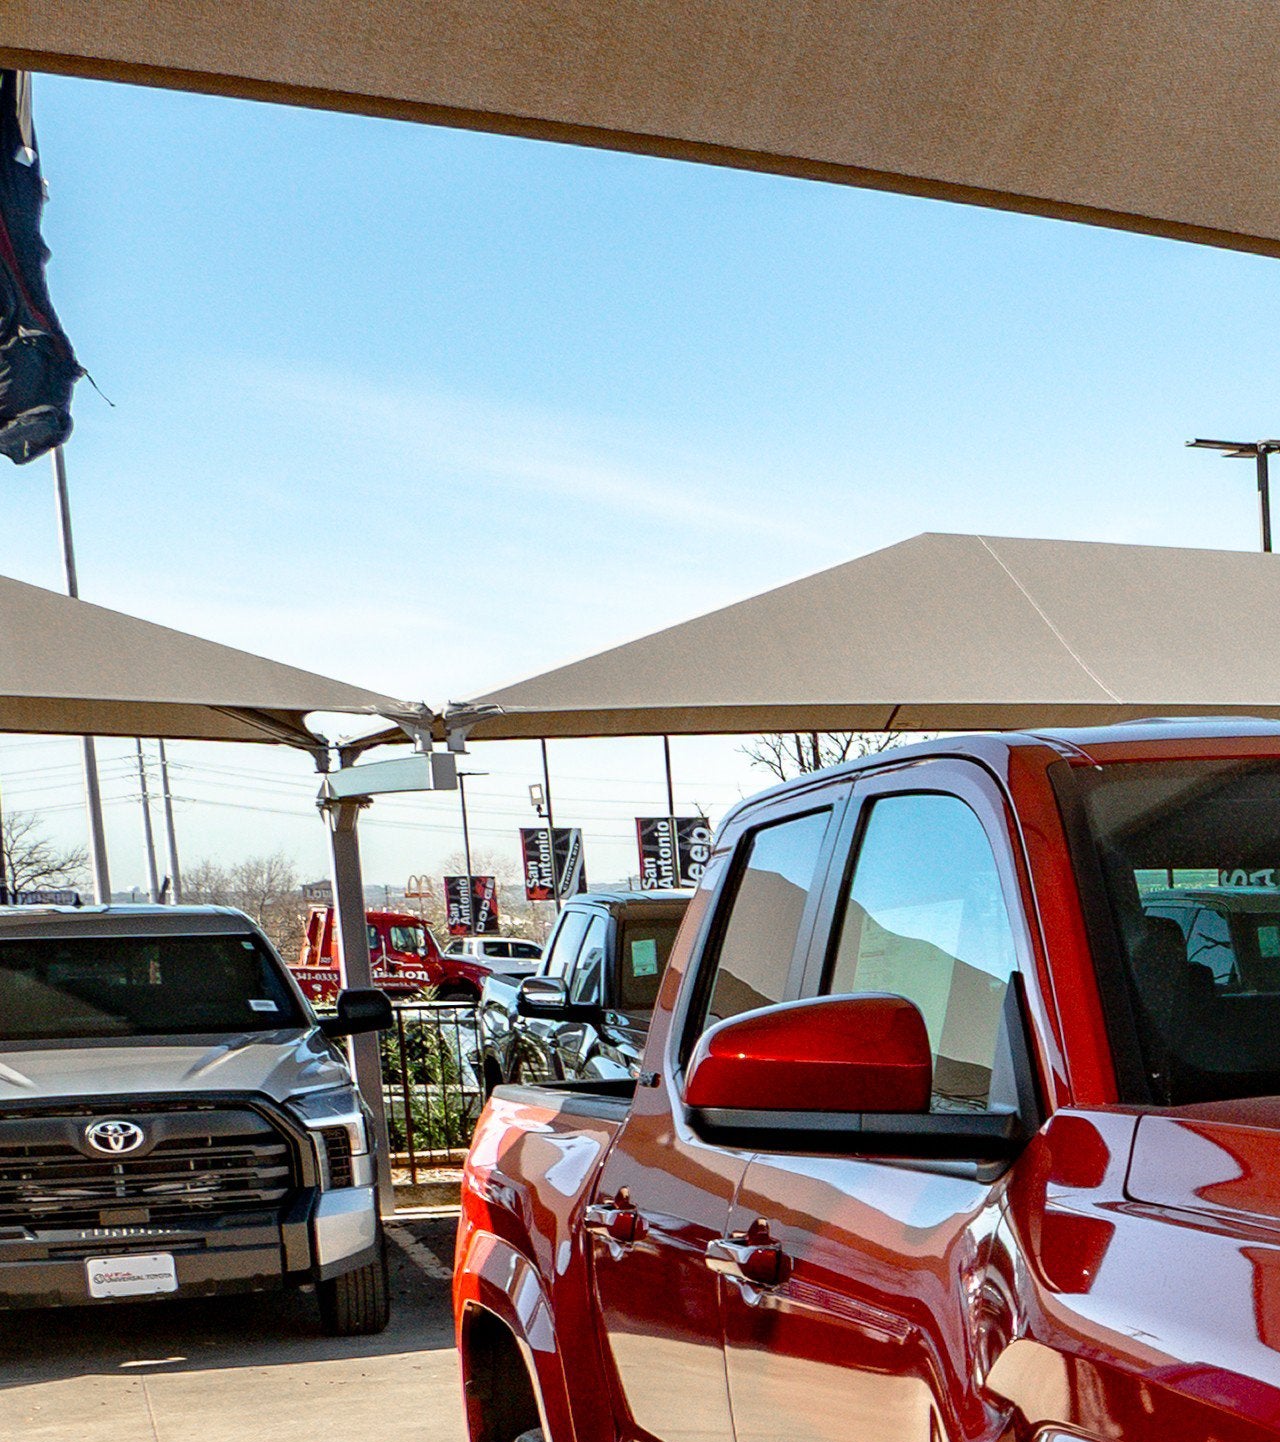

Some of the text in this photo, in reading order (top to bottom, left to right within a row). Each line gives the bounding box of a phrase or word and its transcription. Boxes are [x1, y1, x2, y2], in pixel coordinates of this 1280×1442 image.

[526, 860, 540, 889] San
[534, 830, 554, 889] Antonio
[642, 857, 658, 890] San
[654, 820, 674, 890] Antonio
[449, 903, 460, 926] San
[458, 878, 471, 926] Antonio
